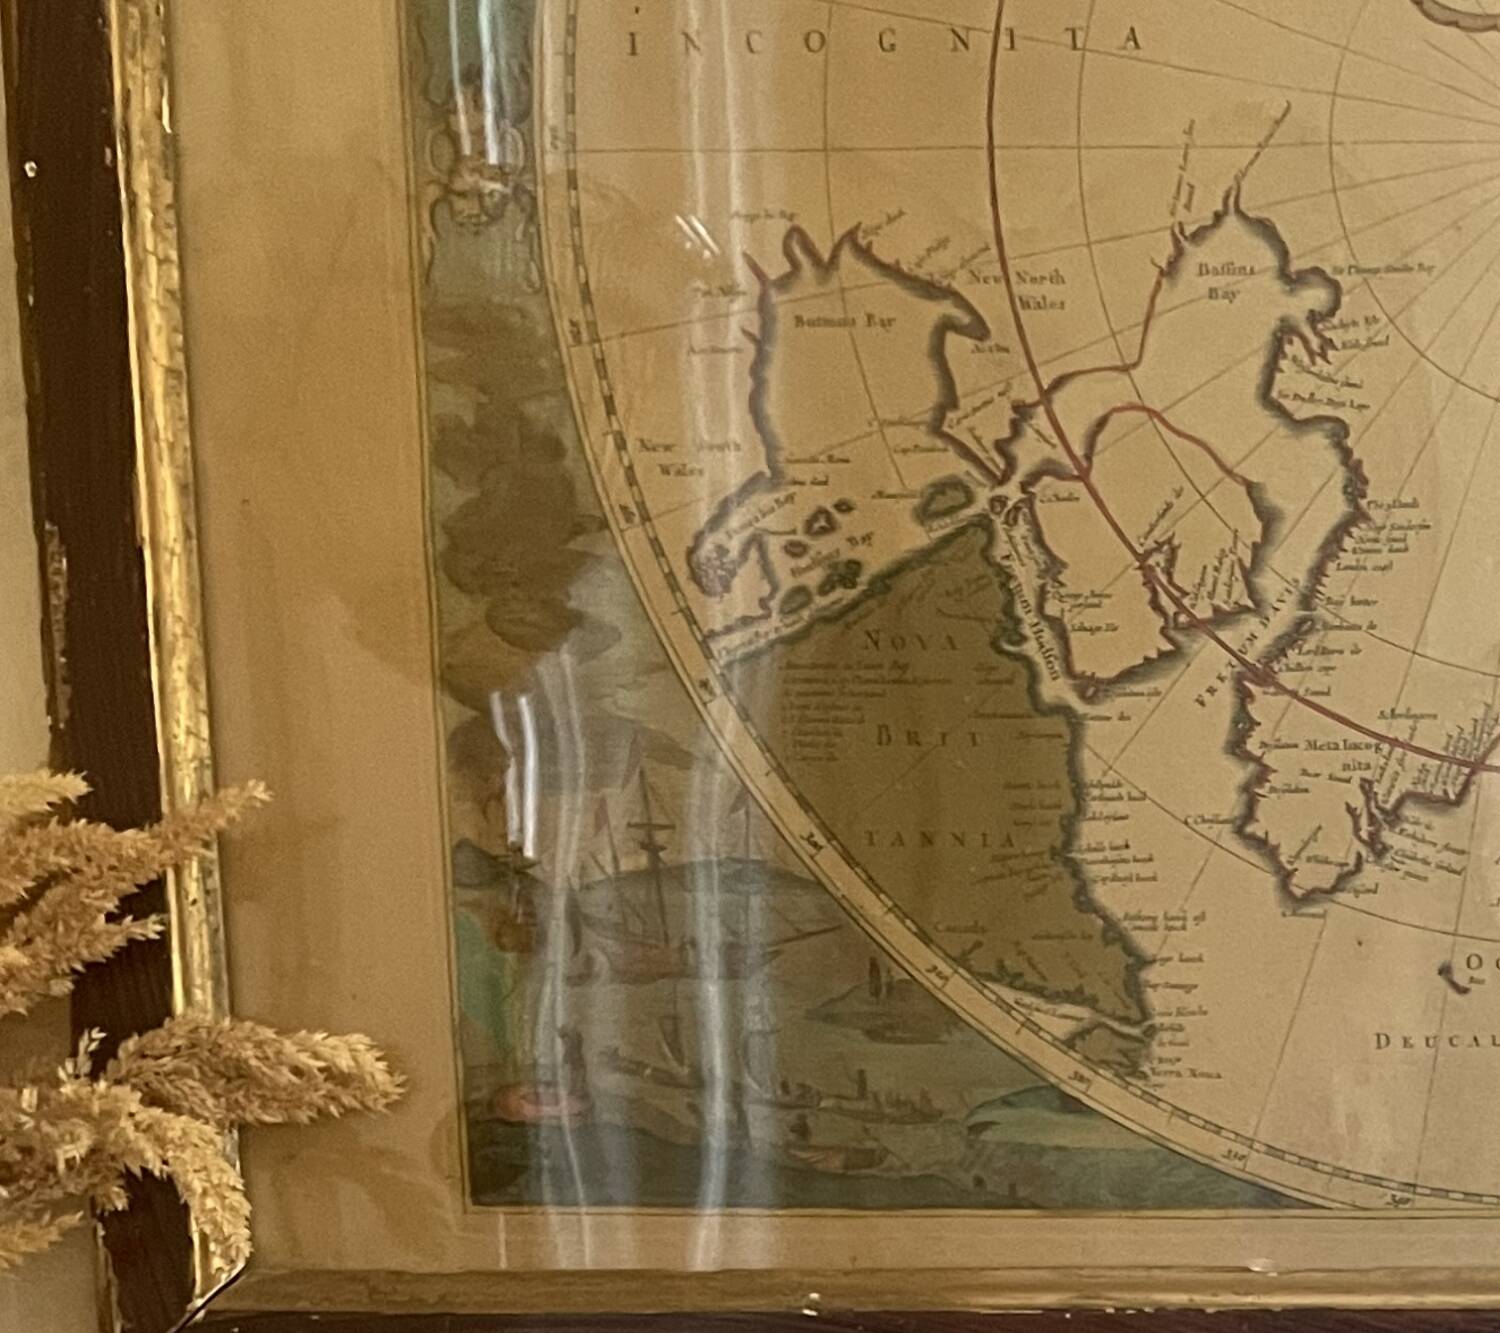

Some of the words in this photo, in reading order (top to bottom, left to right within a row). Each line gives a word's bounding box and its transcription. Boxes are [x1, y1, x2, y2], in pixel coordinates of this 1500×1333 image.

[626, 26, 1142, 56] INCOGNITA
[1015, 267, 1066, 286] North
[1208, 285, 1241, 304] Bay
[863, 628, 959, 651] NOVA
[876, 724, 979, 747] BRIT
[864, 829, 1015, 849] TANNIA
